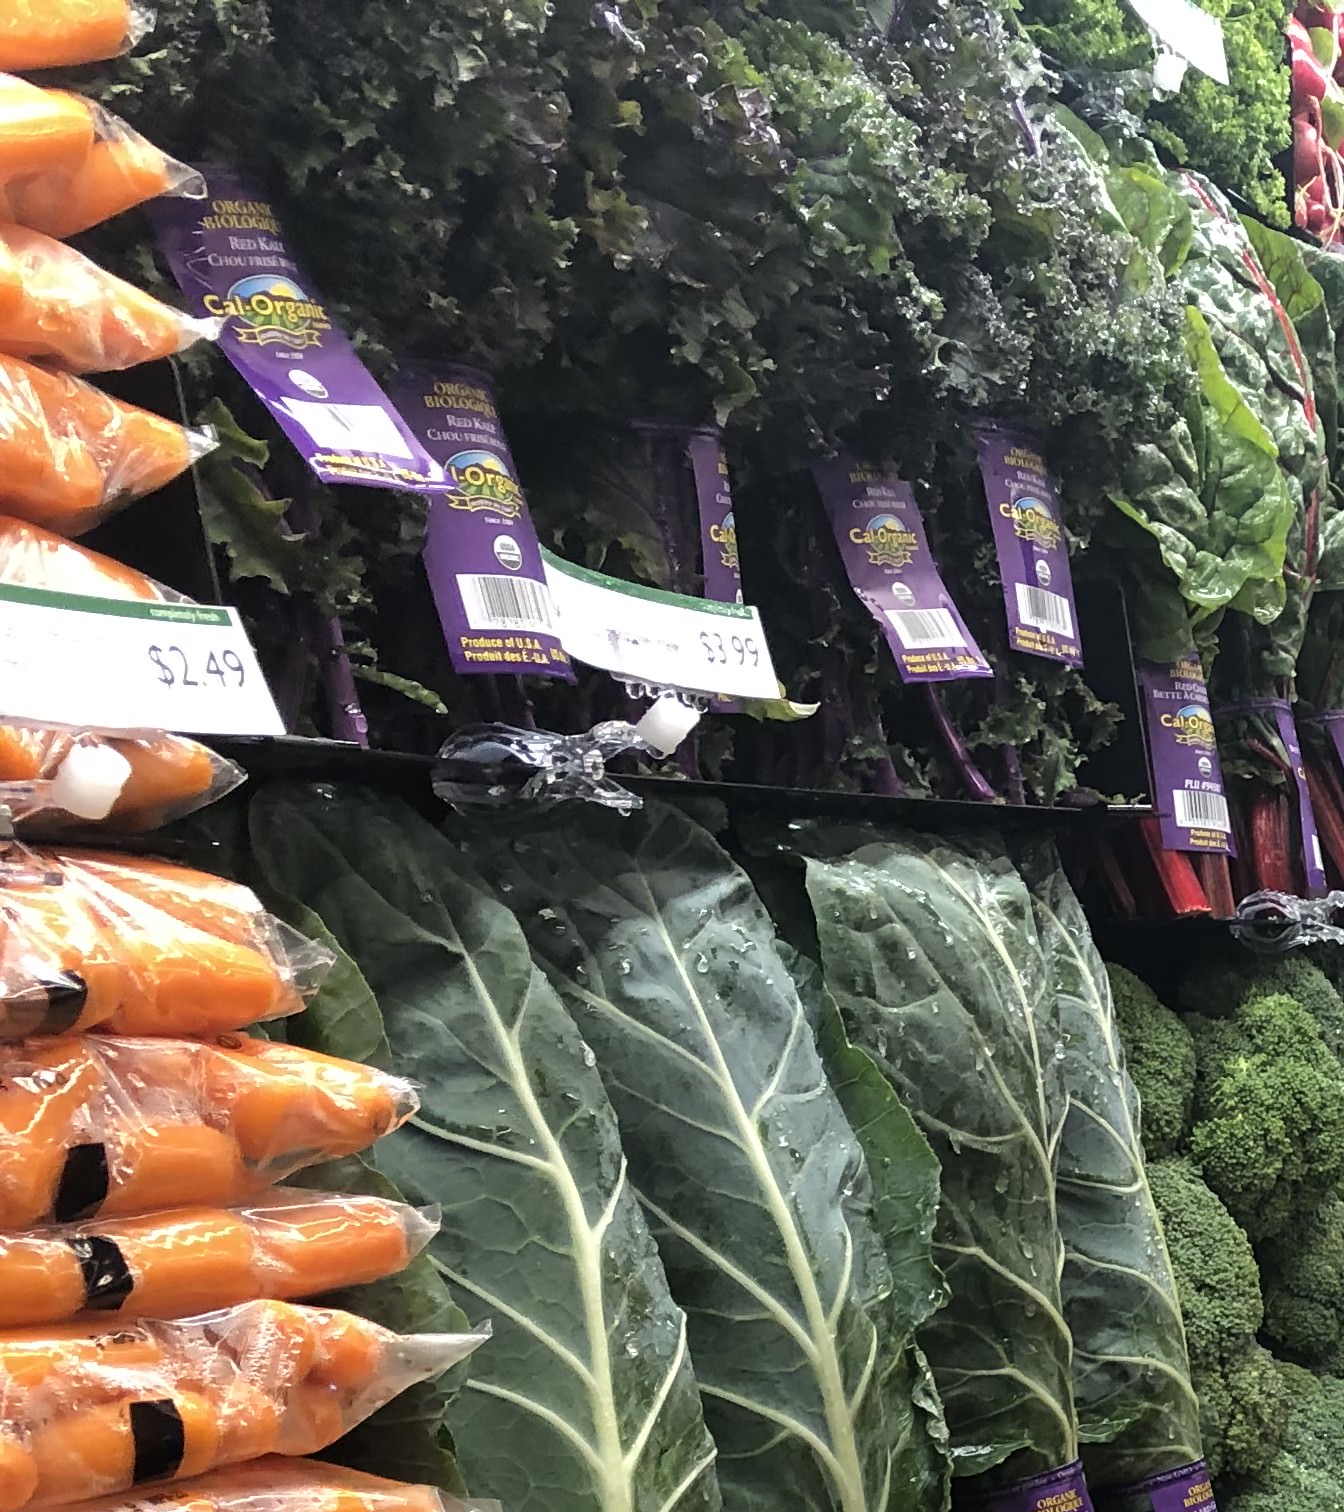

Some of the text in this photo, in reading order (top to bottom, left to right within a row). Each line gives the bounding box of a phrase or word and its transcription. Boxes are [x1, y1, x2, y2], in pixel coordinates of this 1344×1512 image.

[204, 215, 281, 235] BIOLOGIQ
[203, 294, 328, 322] Cal-Organic
[850, 527, 918, 548] Cal-Organic
[699, 630, 759, 667] $399
[148, 645, 244, 689] $2.49
